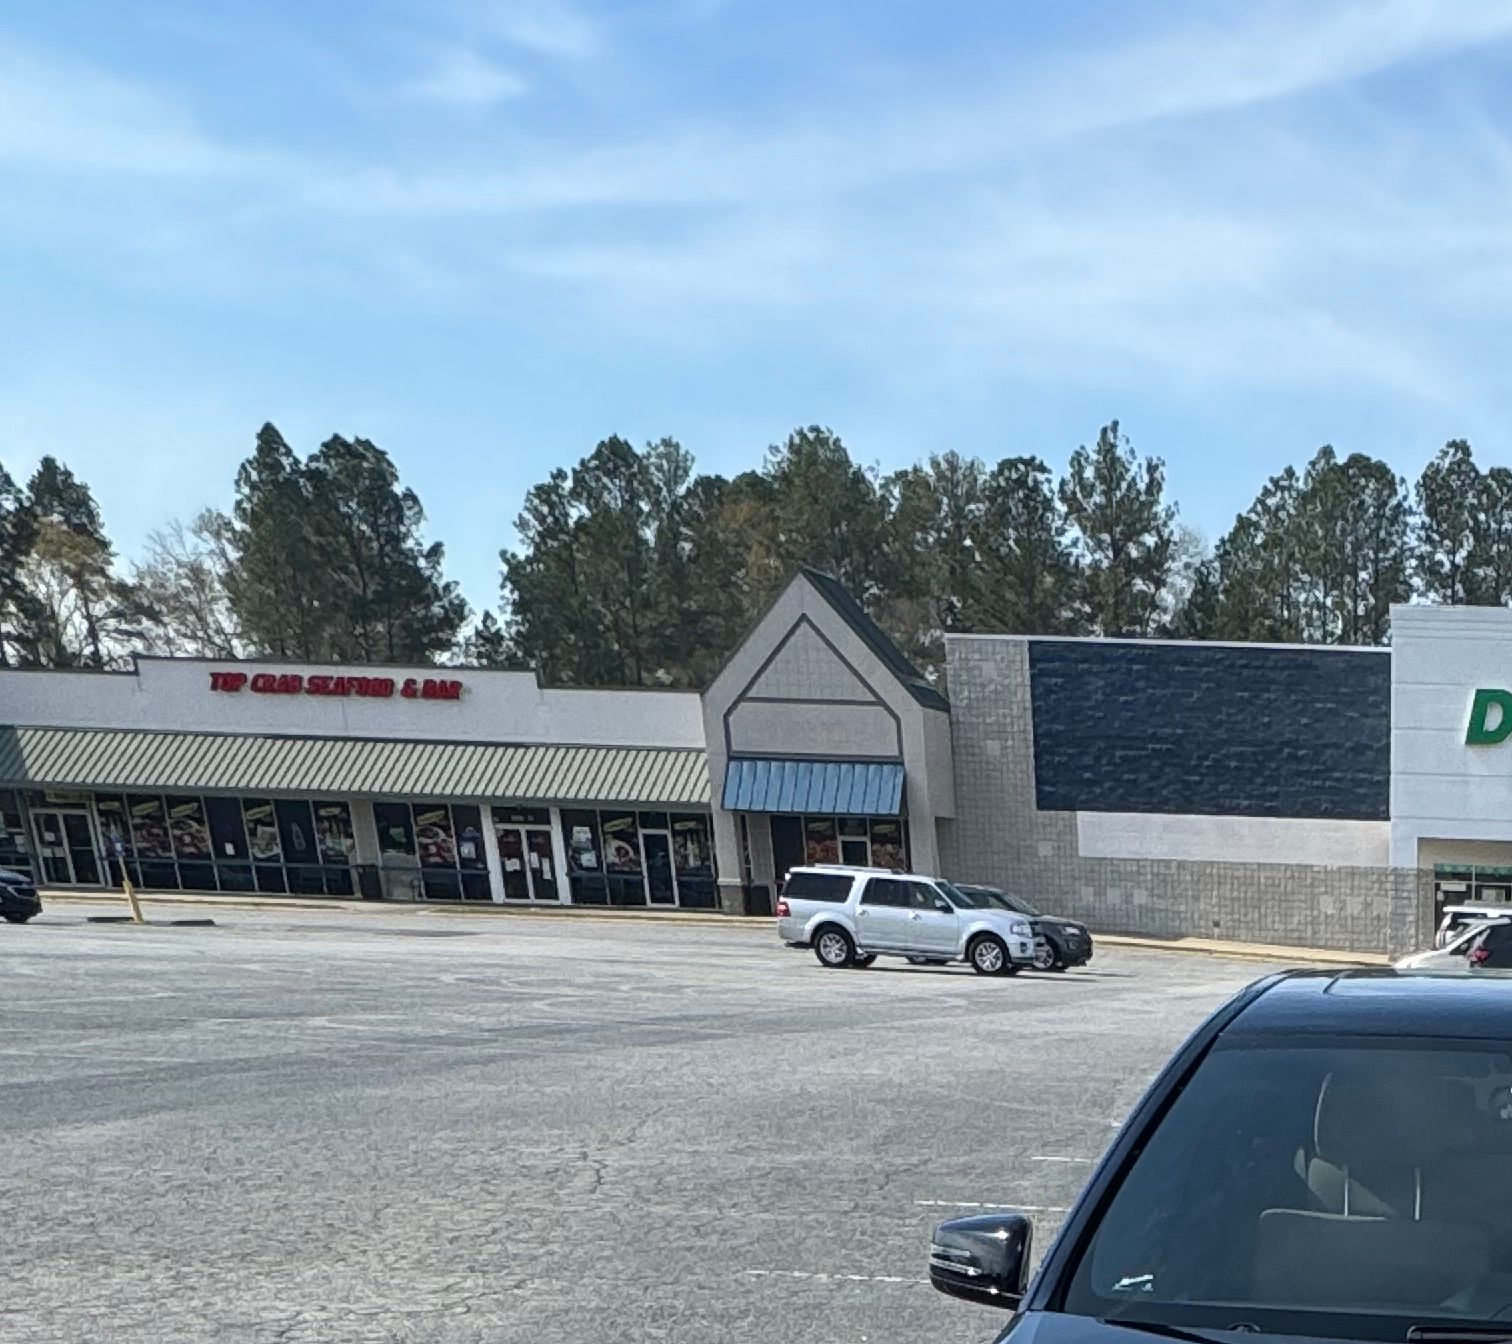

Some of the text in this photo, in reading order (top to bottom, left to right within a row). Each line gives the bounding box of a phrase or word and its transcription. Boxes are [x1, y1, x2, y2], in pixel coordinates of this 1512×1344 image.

[304, 675, 394, 697] SEAFOOD
[400, 678, 418, 698] &
[421, 679, 463, 700] BAR
